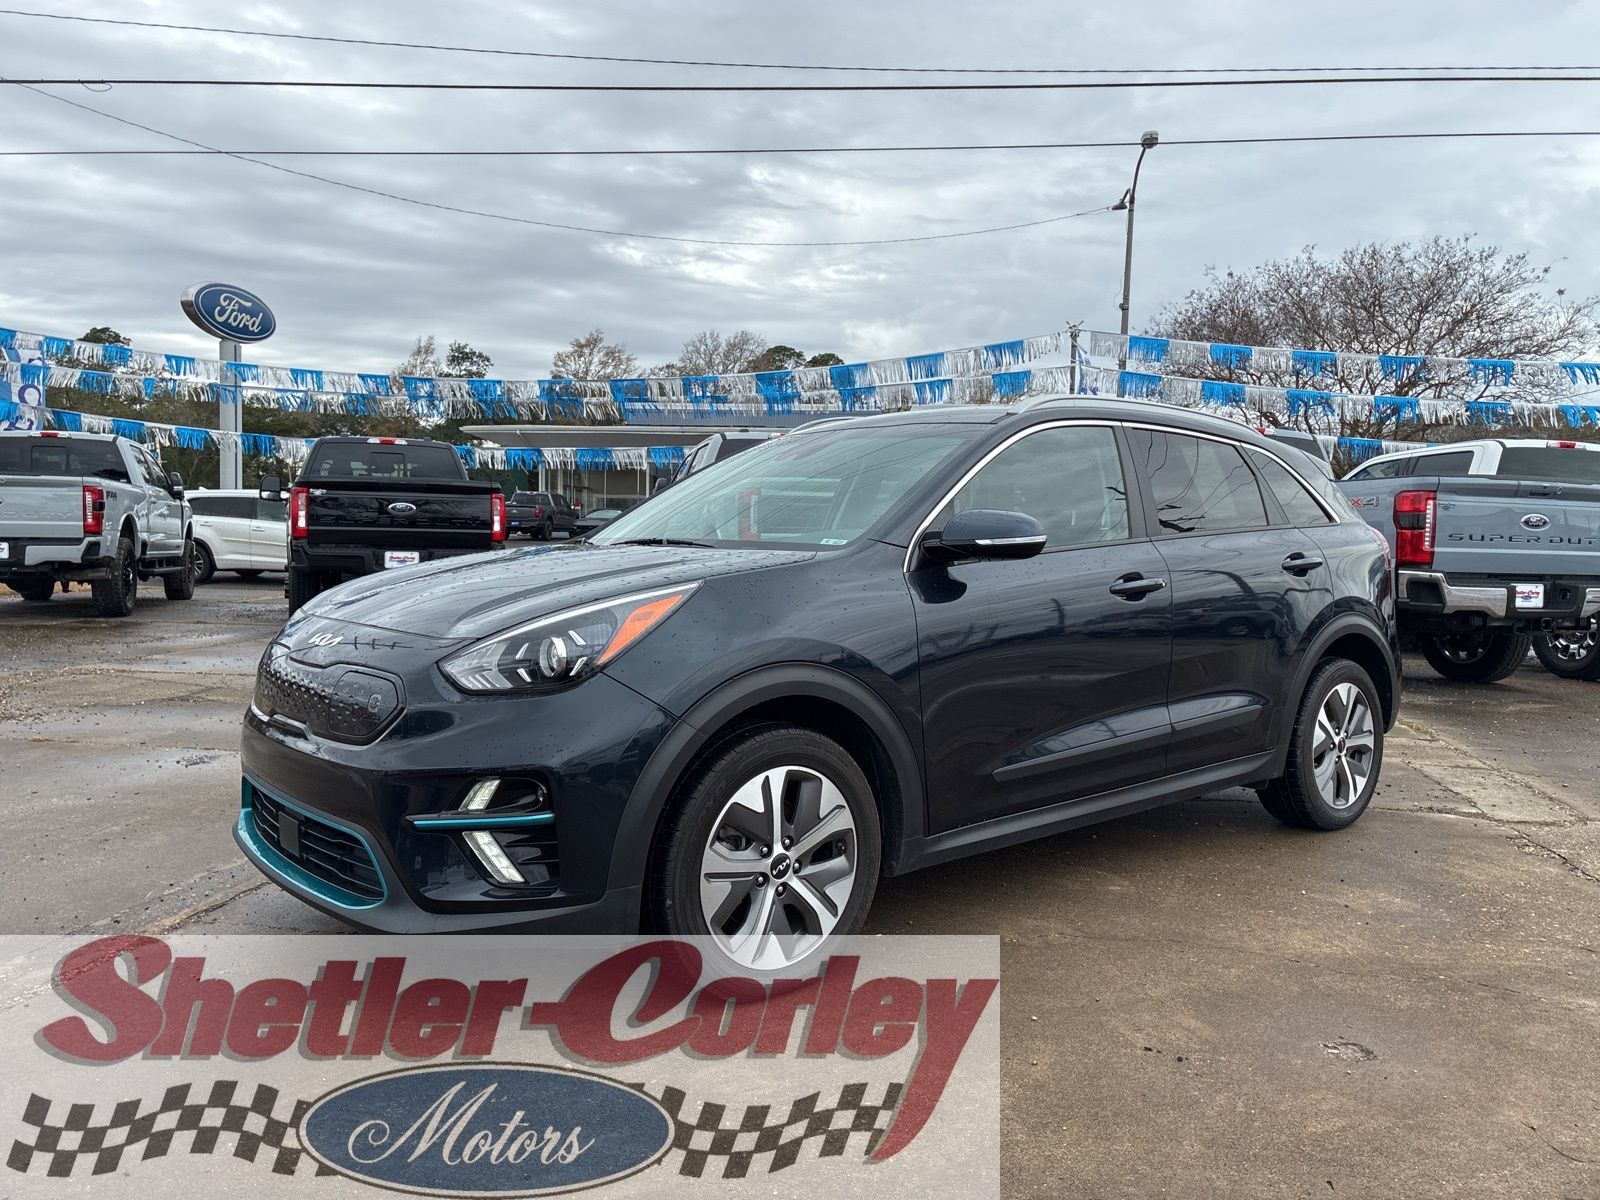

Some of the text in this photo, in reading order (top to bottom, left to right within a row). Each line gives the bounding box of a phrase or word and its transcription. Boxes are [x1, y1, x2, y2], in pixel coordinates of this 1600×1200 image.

[215, 292, 263, 332] Ford
[1448, 533, 1541, 543] SUPER
[308, 631, 344, 648] KIA
